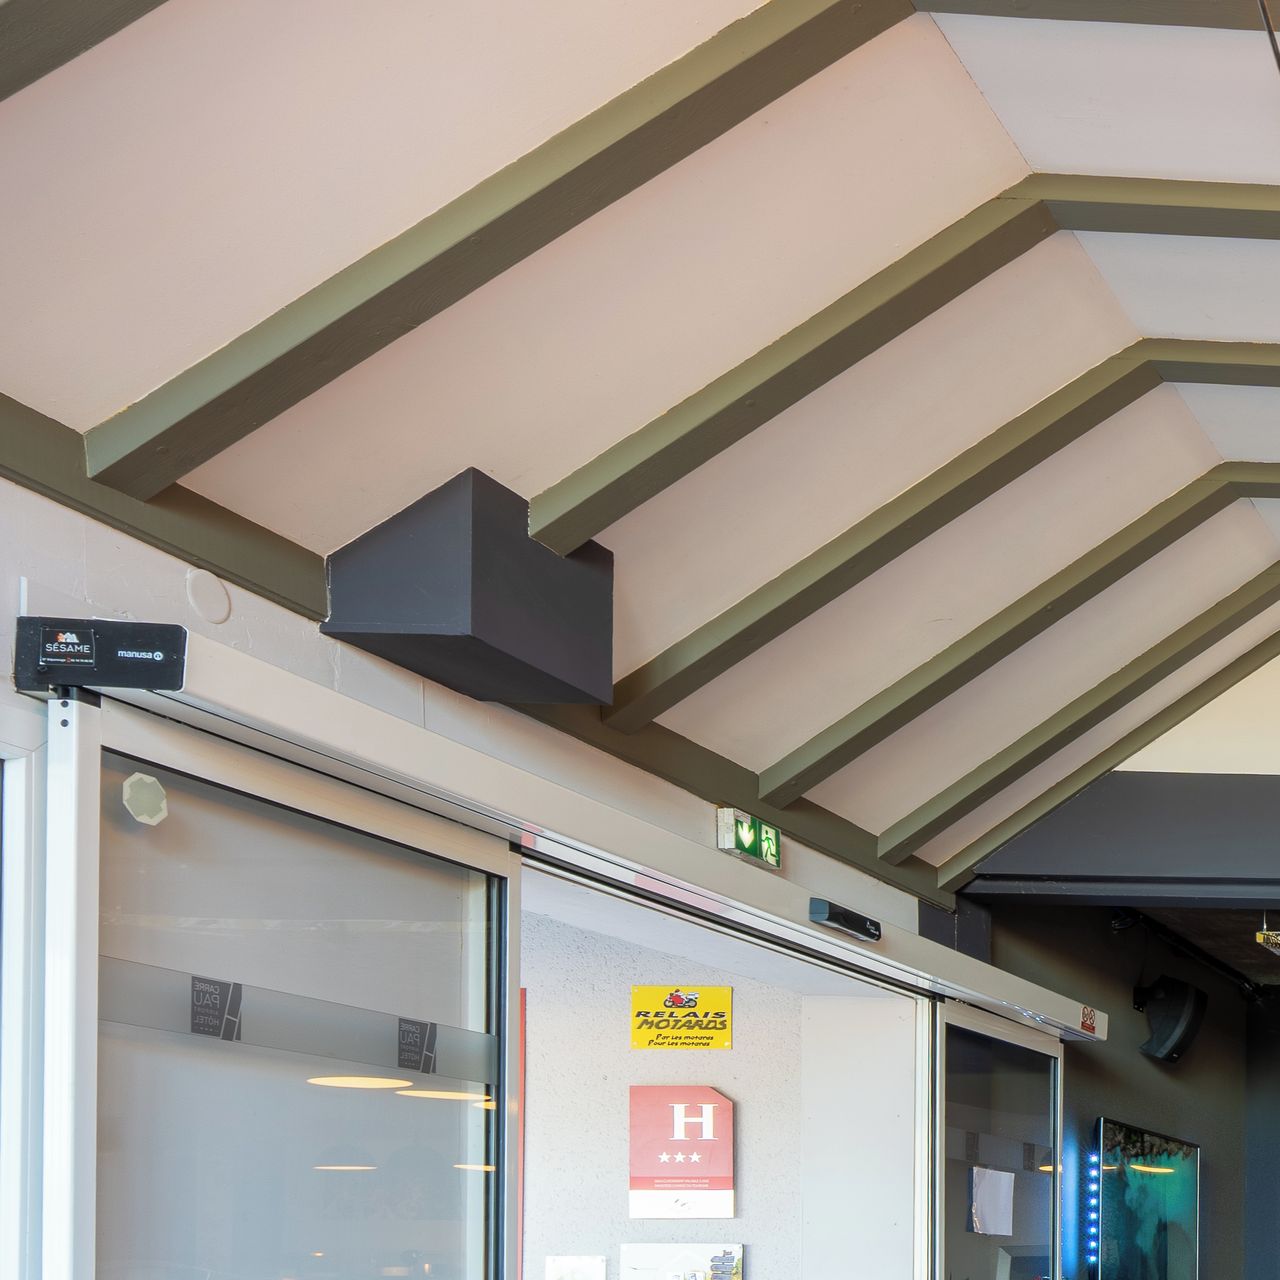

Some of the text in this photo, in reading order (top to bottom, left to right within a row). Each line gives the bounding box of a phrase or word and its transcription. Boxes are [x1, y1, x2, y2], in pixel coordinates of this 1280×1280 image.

[45, 643, 91, 653] SÉSAME
[117, 650, 153, 659] manusa
[635, 1011, 727, 1019] RELAIS
[636, 1019, 728, 1030] MOTARDS
[668, 1103, 719, 1141] H
